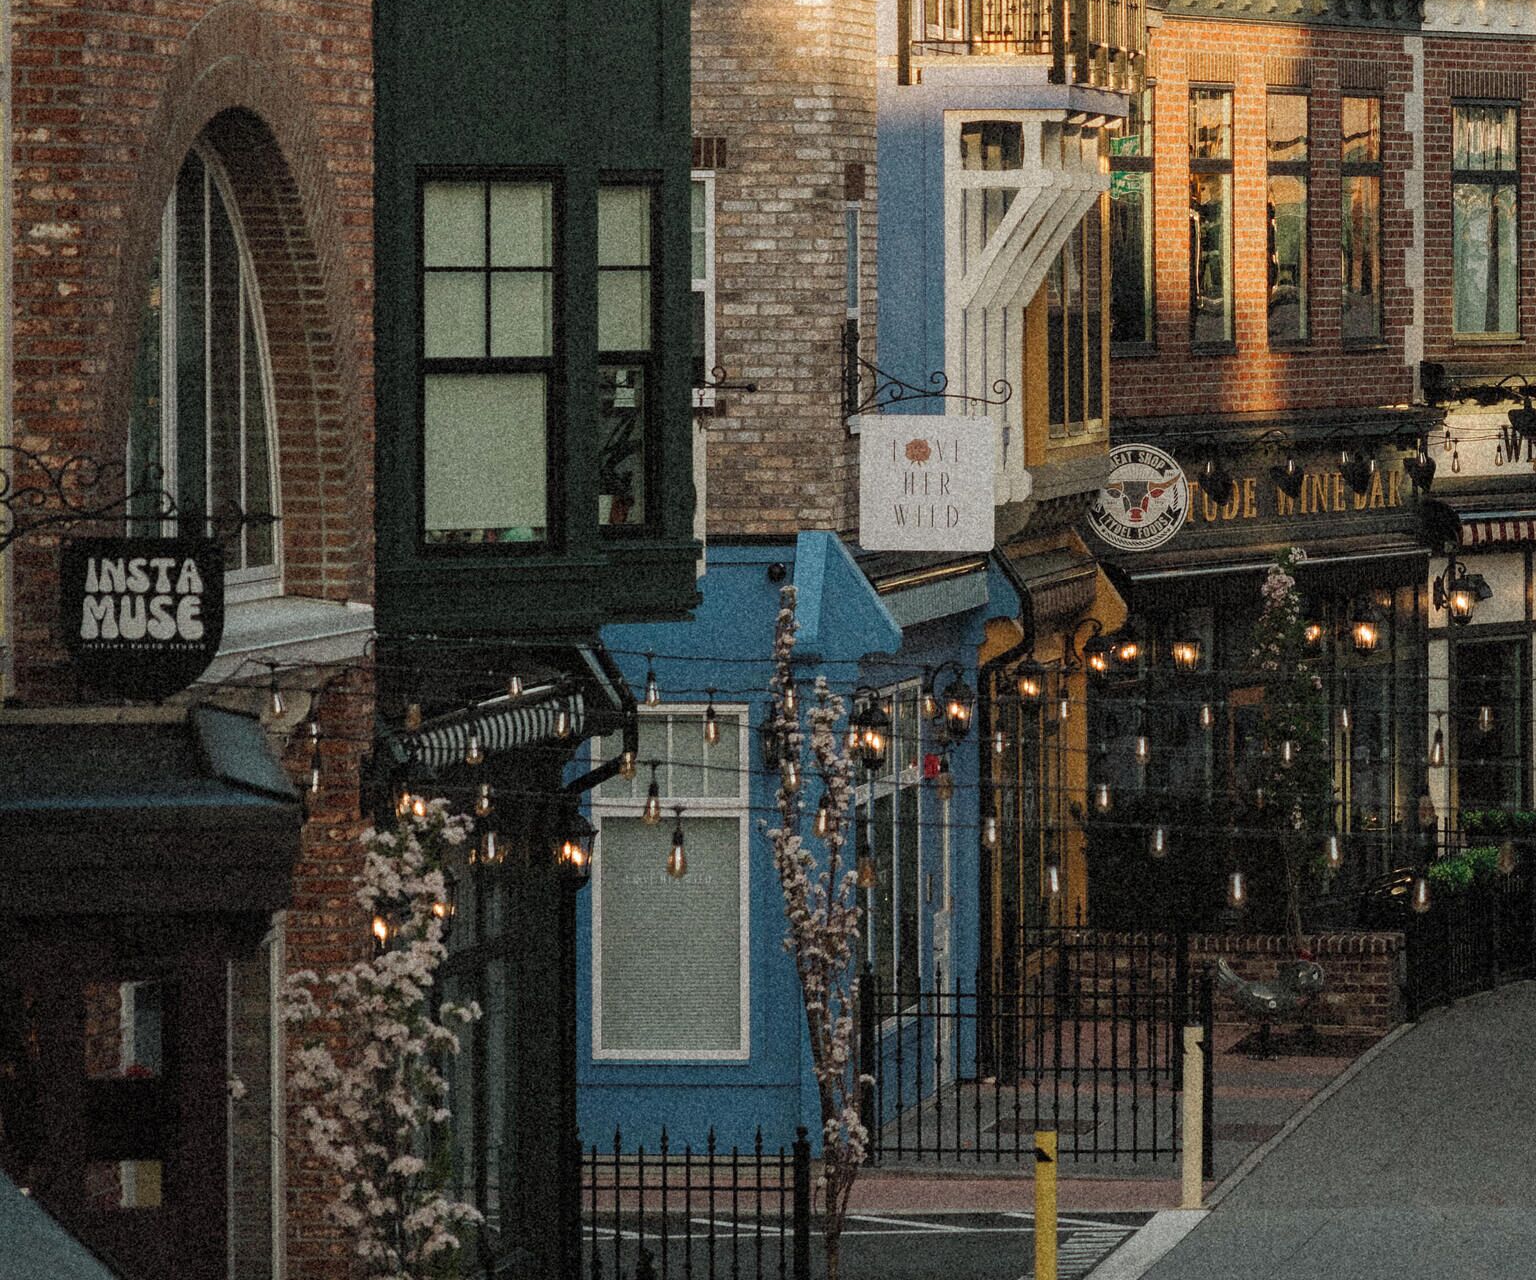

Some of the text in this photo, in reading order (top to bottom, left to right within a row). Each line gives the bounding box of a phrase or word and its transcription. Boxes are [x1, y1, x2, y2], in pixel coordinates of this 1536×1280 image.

[1138, 451, 1166, 470] SHOP
[904, 471, 950, 495] HER
[1137, 516, 1169, 539] FOODS
[85, 557, 203, 593] INSTA
[80, 595, 204, 640] MUSE
